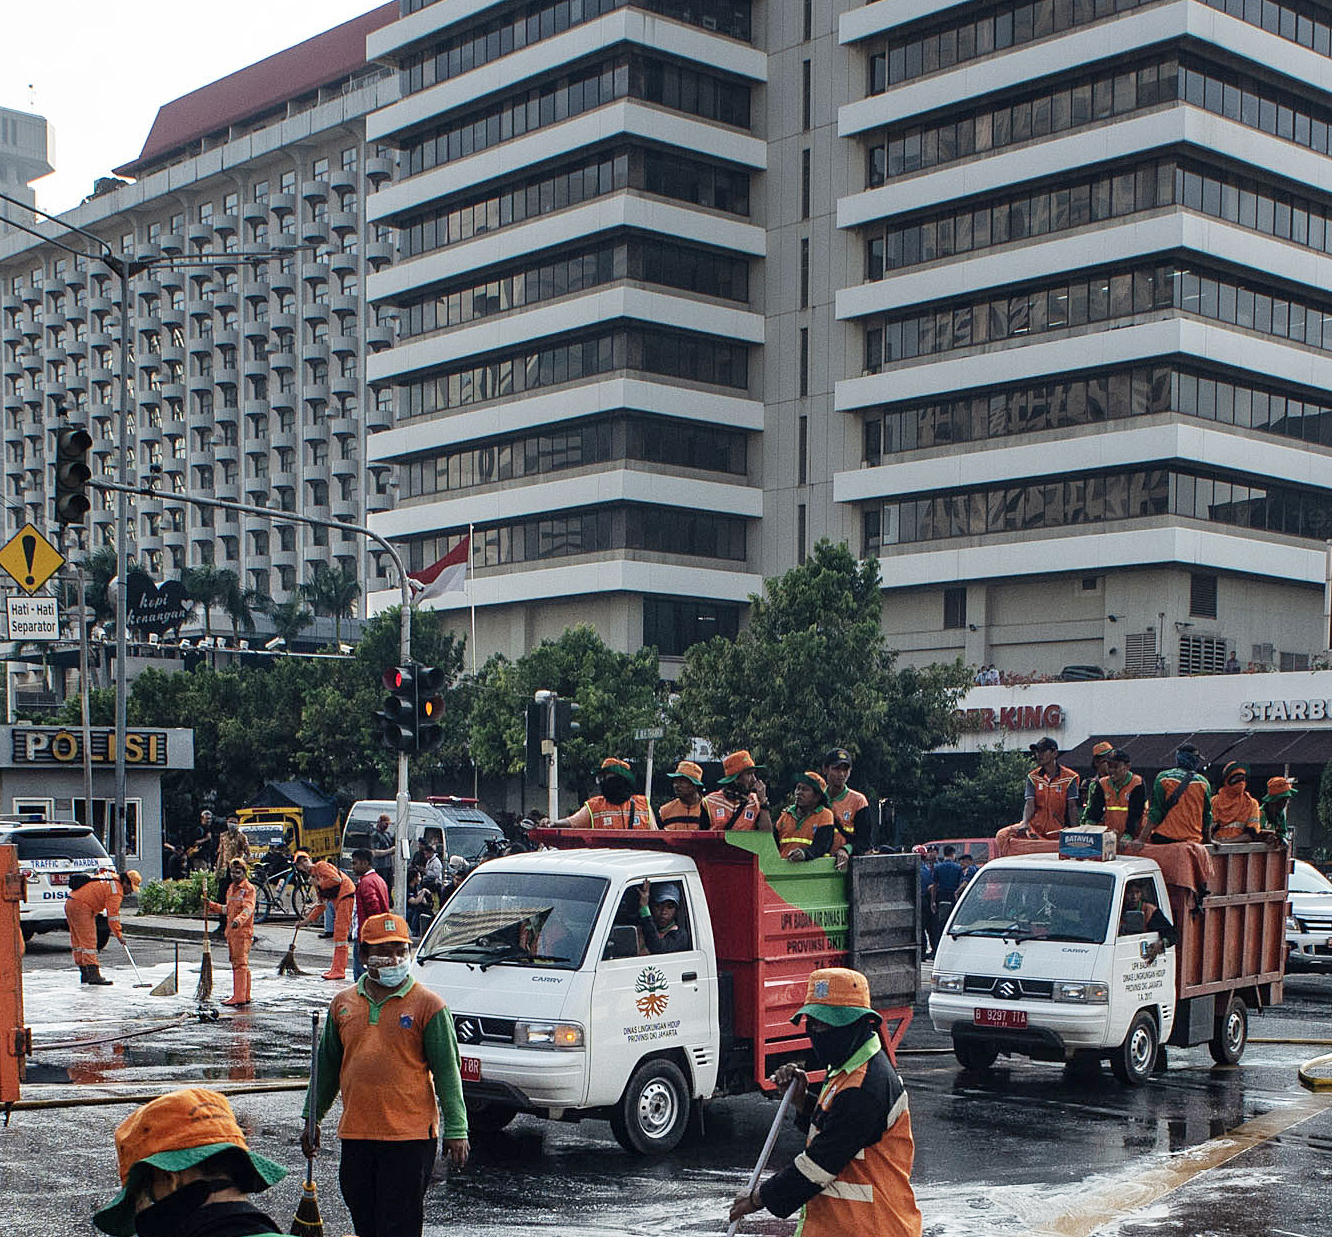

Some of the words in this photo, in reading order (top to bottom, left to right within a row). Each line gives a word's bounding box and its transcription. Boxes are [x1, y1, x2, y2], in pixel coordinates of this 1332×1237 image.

[139, 592, 168, 609] kopi
[12, 603, 29, 616] Hati
[37, 603, 55, 616] Hati
[127, 608, 186, 625] kenangan
[12, 621, 56, 635] Separator
[1000, 704, 1061, 730] KING
[26, 732, 158, 763] POISI
[1064, 835, 1094, 845] BATAVIA
[31, 860, 58, 868] TRAFFIC
[73, 859, 99, 867] WARDEN
[532, 976, 563, 984] CARRY
[623, 1025, 638, 1036] DINAS
[627, 1033, 649, 1043] PROVINSI
